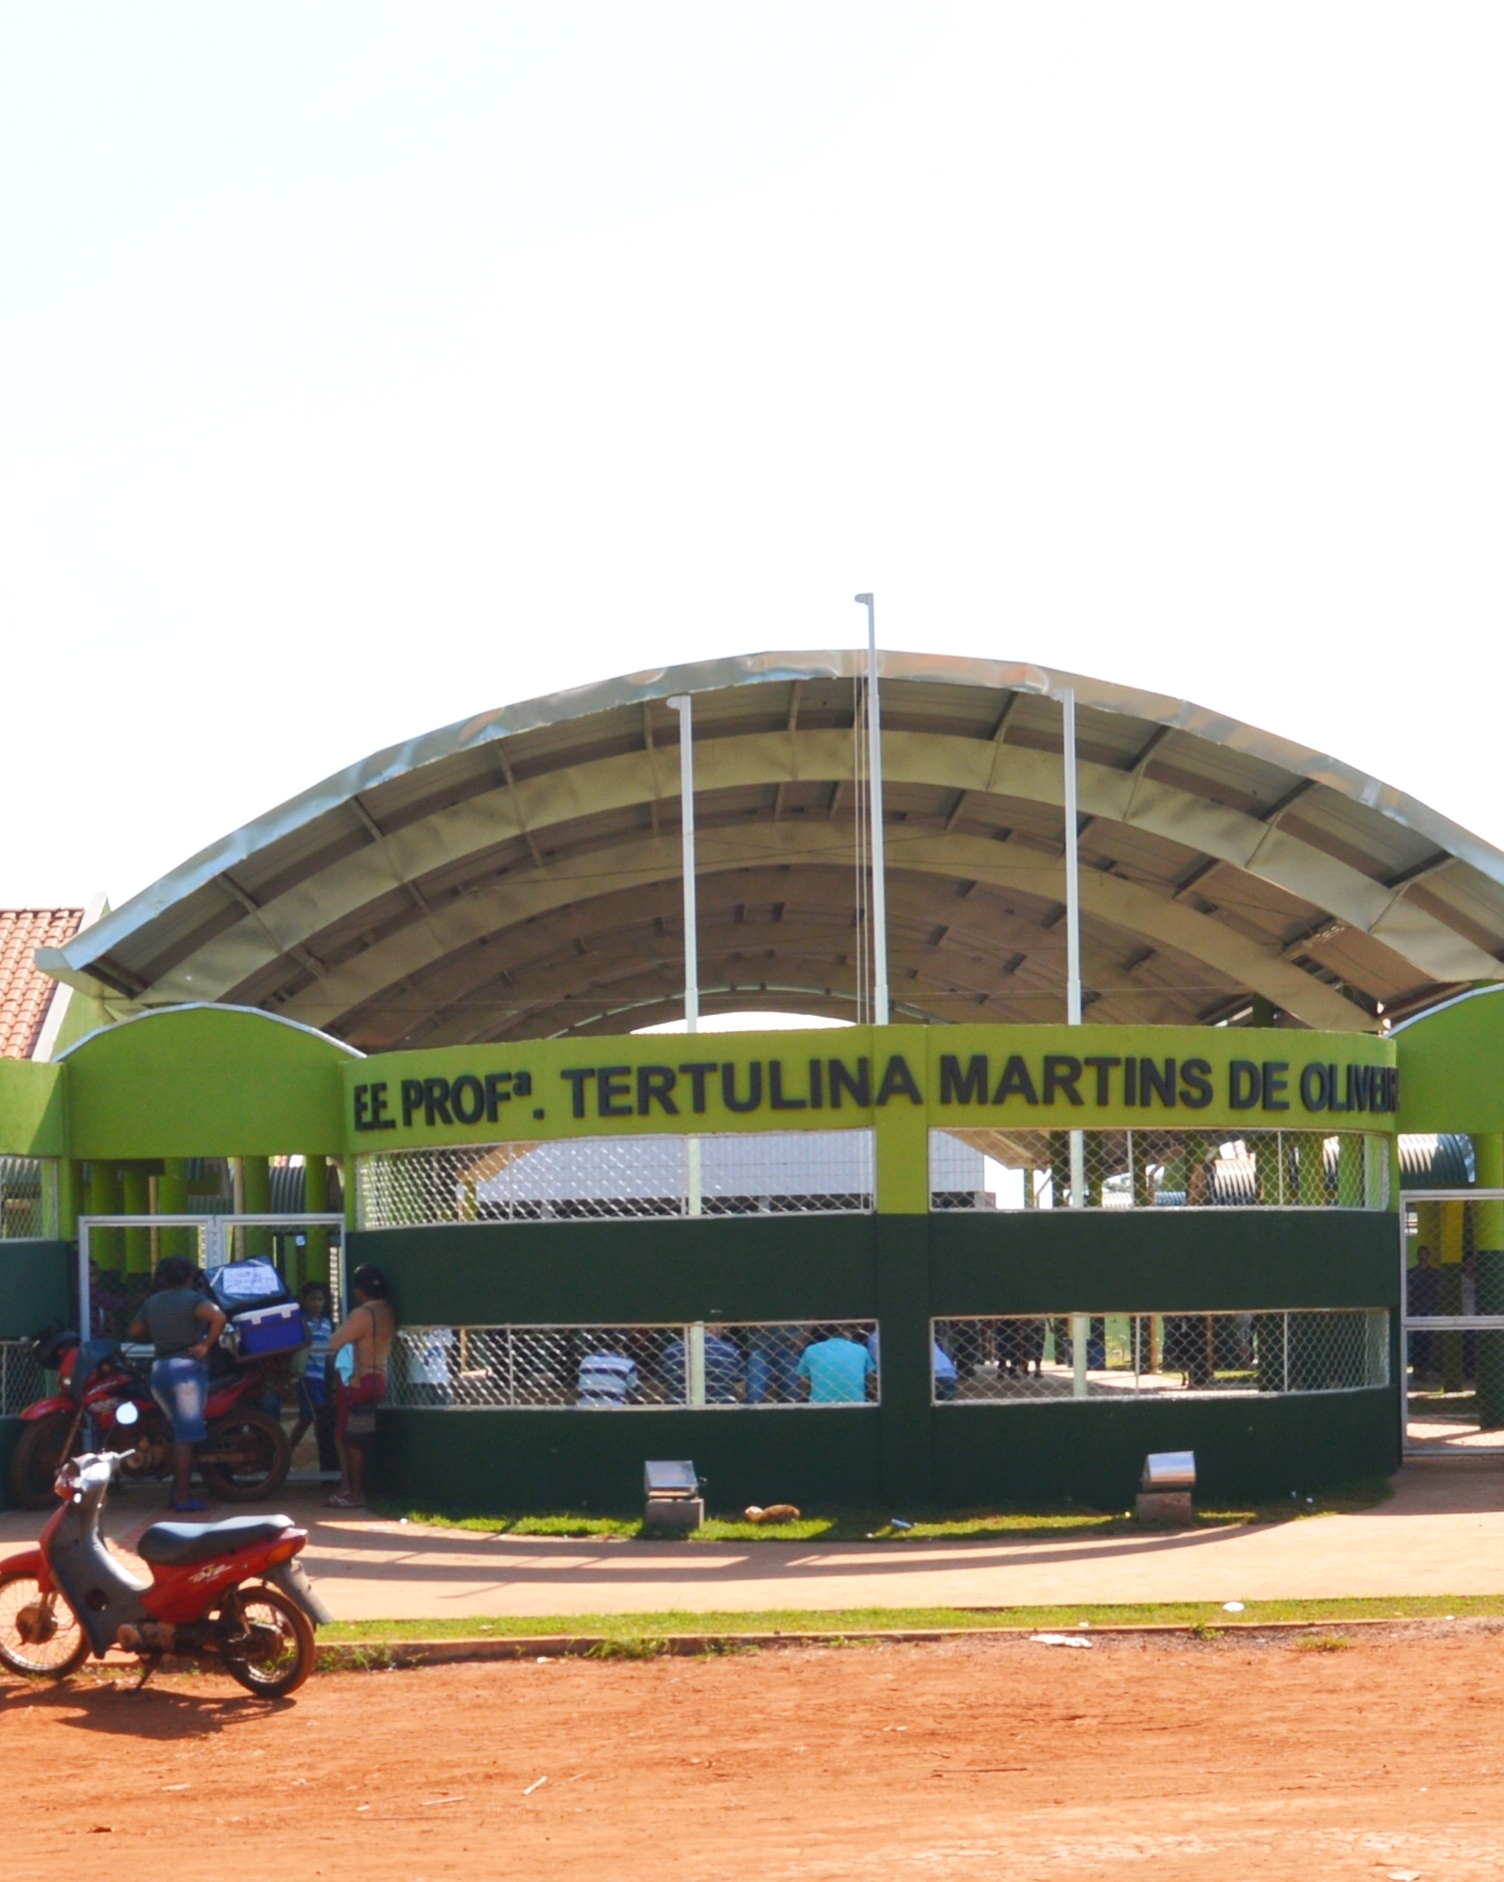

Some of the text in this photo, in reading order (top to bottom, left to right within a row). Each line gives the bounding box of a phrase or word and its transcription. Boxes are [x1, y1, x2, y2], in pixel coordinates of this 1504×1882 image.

[560, 1054, 925, 1119] TERTULINA
[938, 1053, 1215, 1109] MARTINS
[1228, 1059, 1291, 1111] DE
